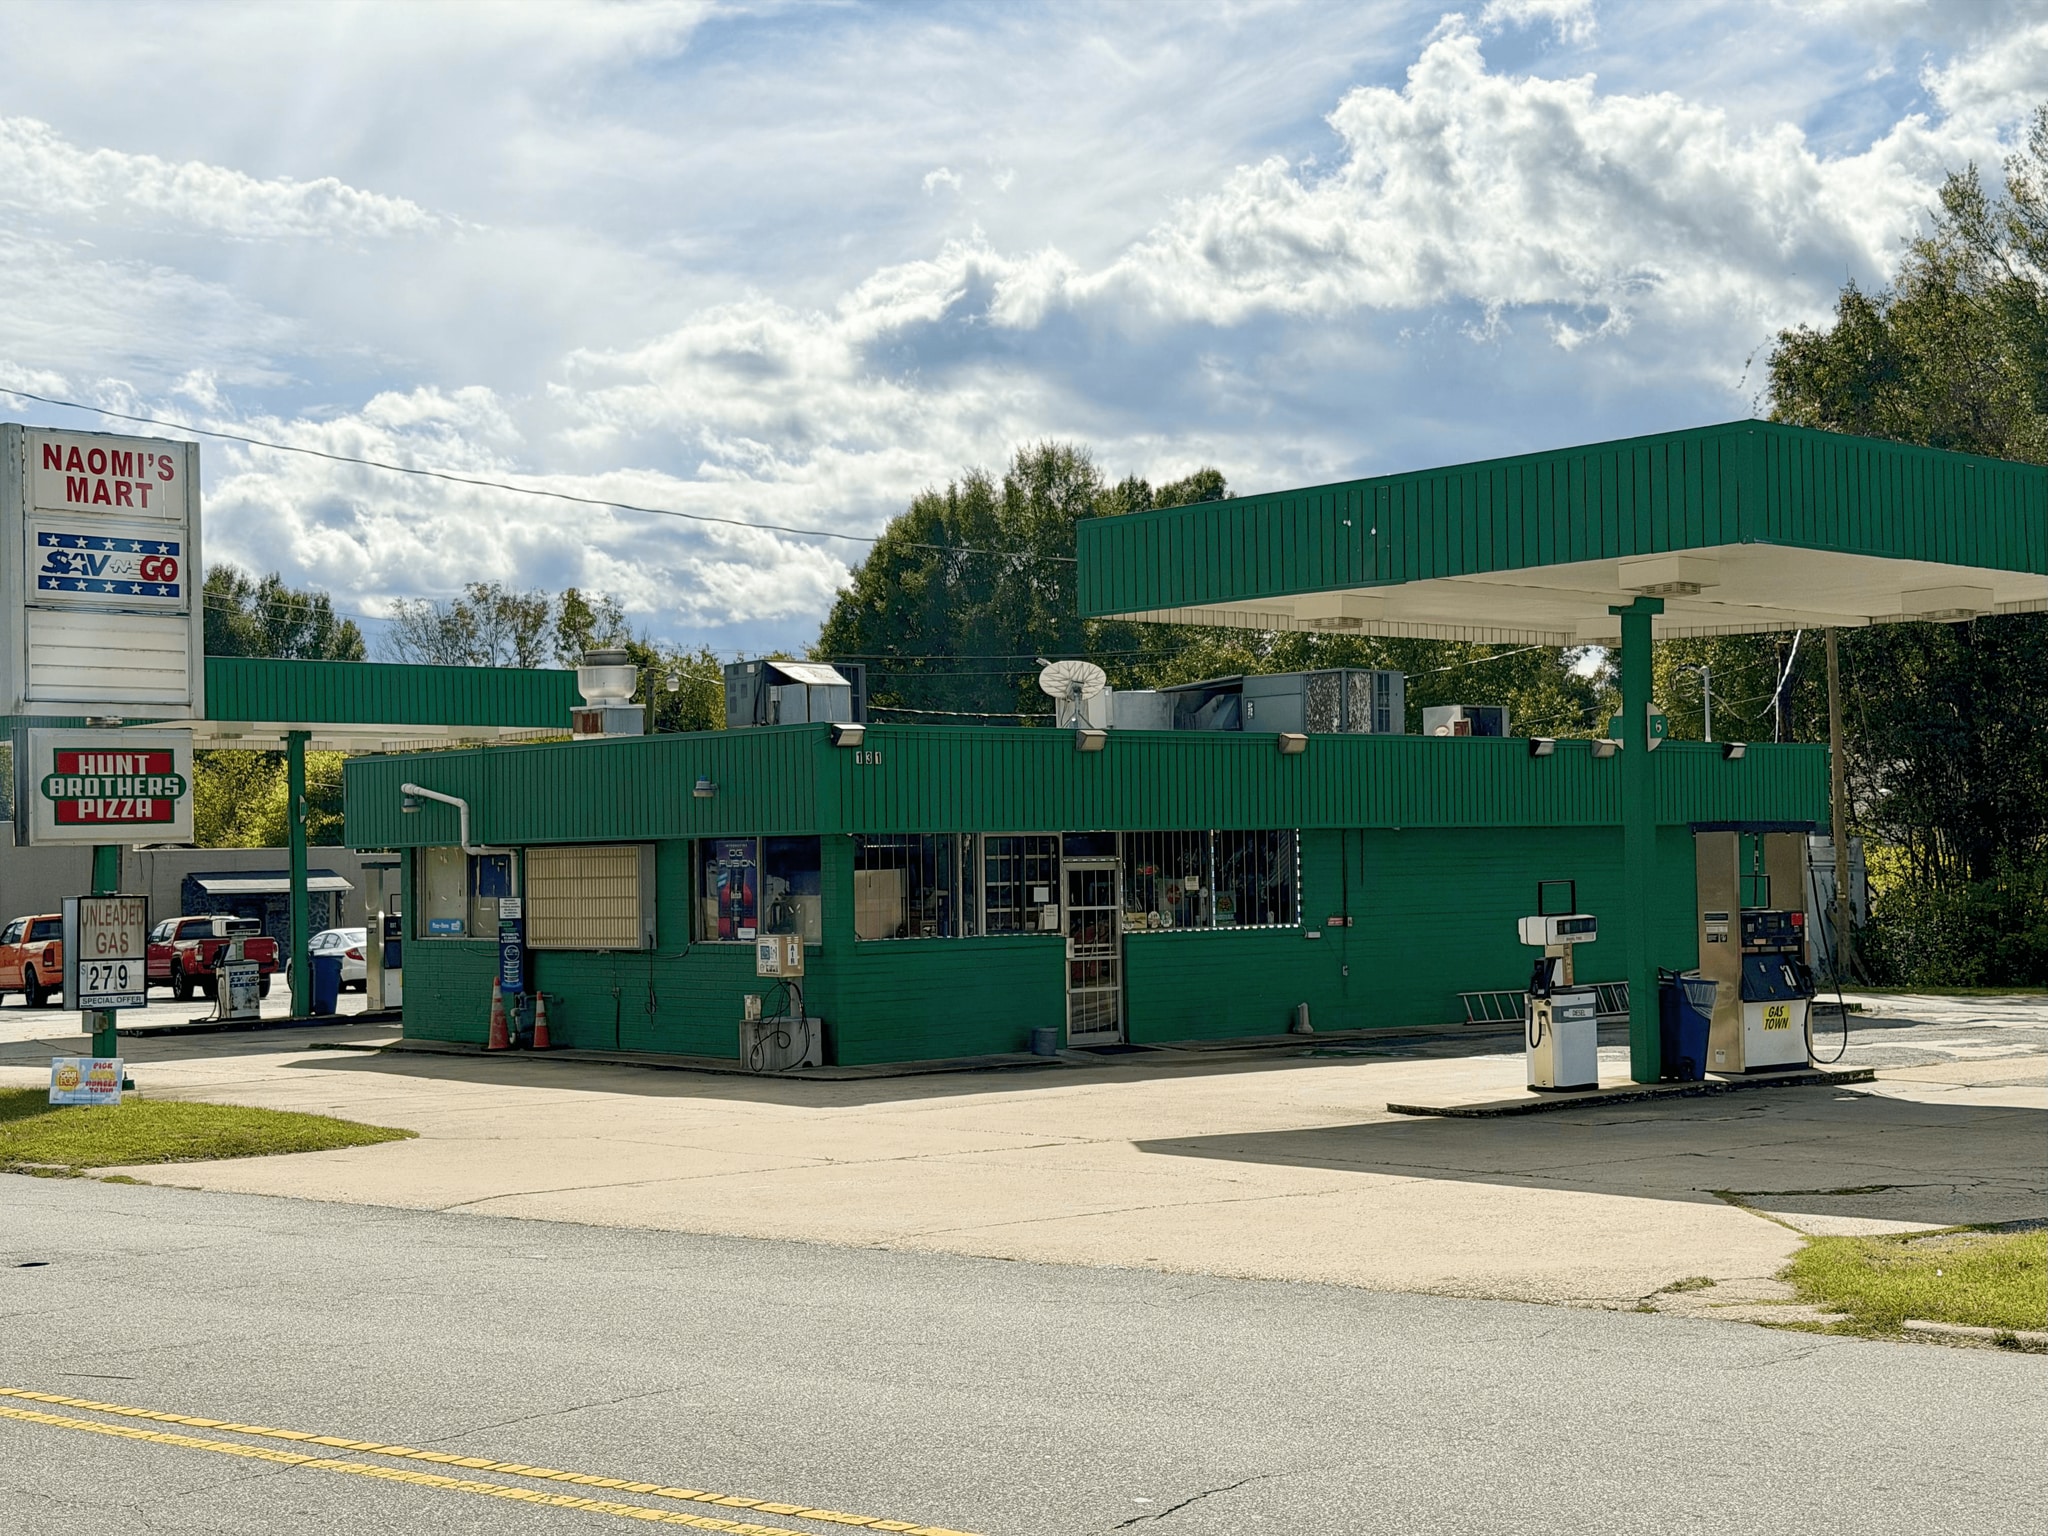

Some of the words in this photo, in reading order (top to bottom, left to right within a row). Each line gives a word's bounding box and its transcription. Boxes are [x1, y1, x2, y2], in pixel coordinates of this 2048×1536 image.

[43, 443, 174, 481] NAOMI'S
[66, 476, 153, 508] MART
[140, 556, 178, 582] GO
[1655, 720, 1662, 733] 6
[78, 755, 149, 775] HUNT
[856, 751, 881, 764] 131
[49, 777, 180, 797] BROTHERS
[78, 798, 153, 819] PIZZA
[719, 860, 756, 868] FUSION
[82, 904, 144, 927] UNLEADED
[96, 932, 129, 954] GAS
[82, 997, 114, 1005] SPECIAL
[116, 995, 142, 1004] OFFER
[1572, 1009, 1586, 1017] DIESEL
[1768, 1005, 1785, 1018] GAS
[1764, 1017, 1789, 1031] TOWN
[92, 1062, 113, 1070] PICK
